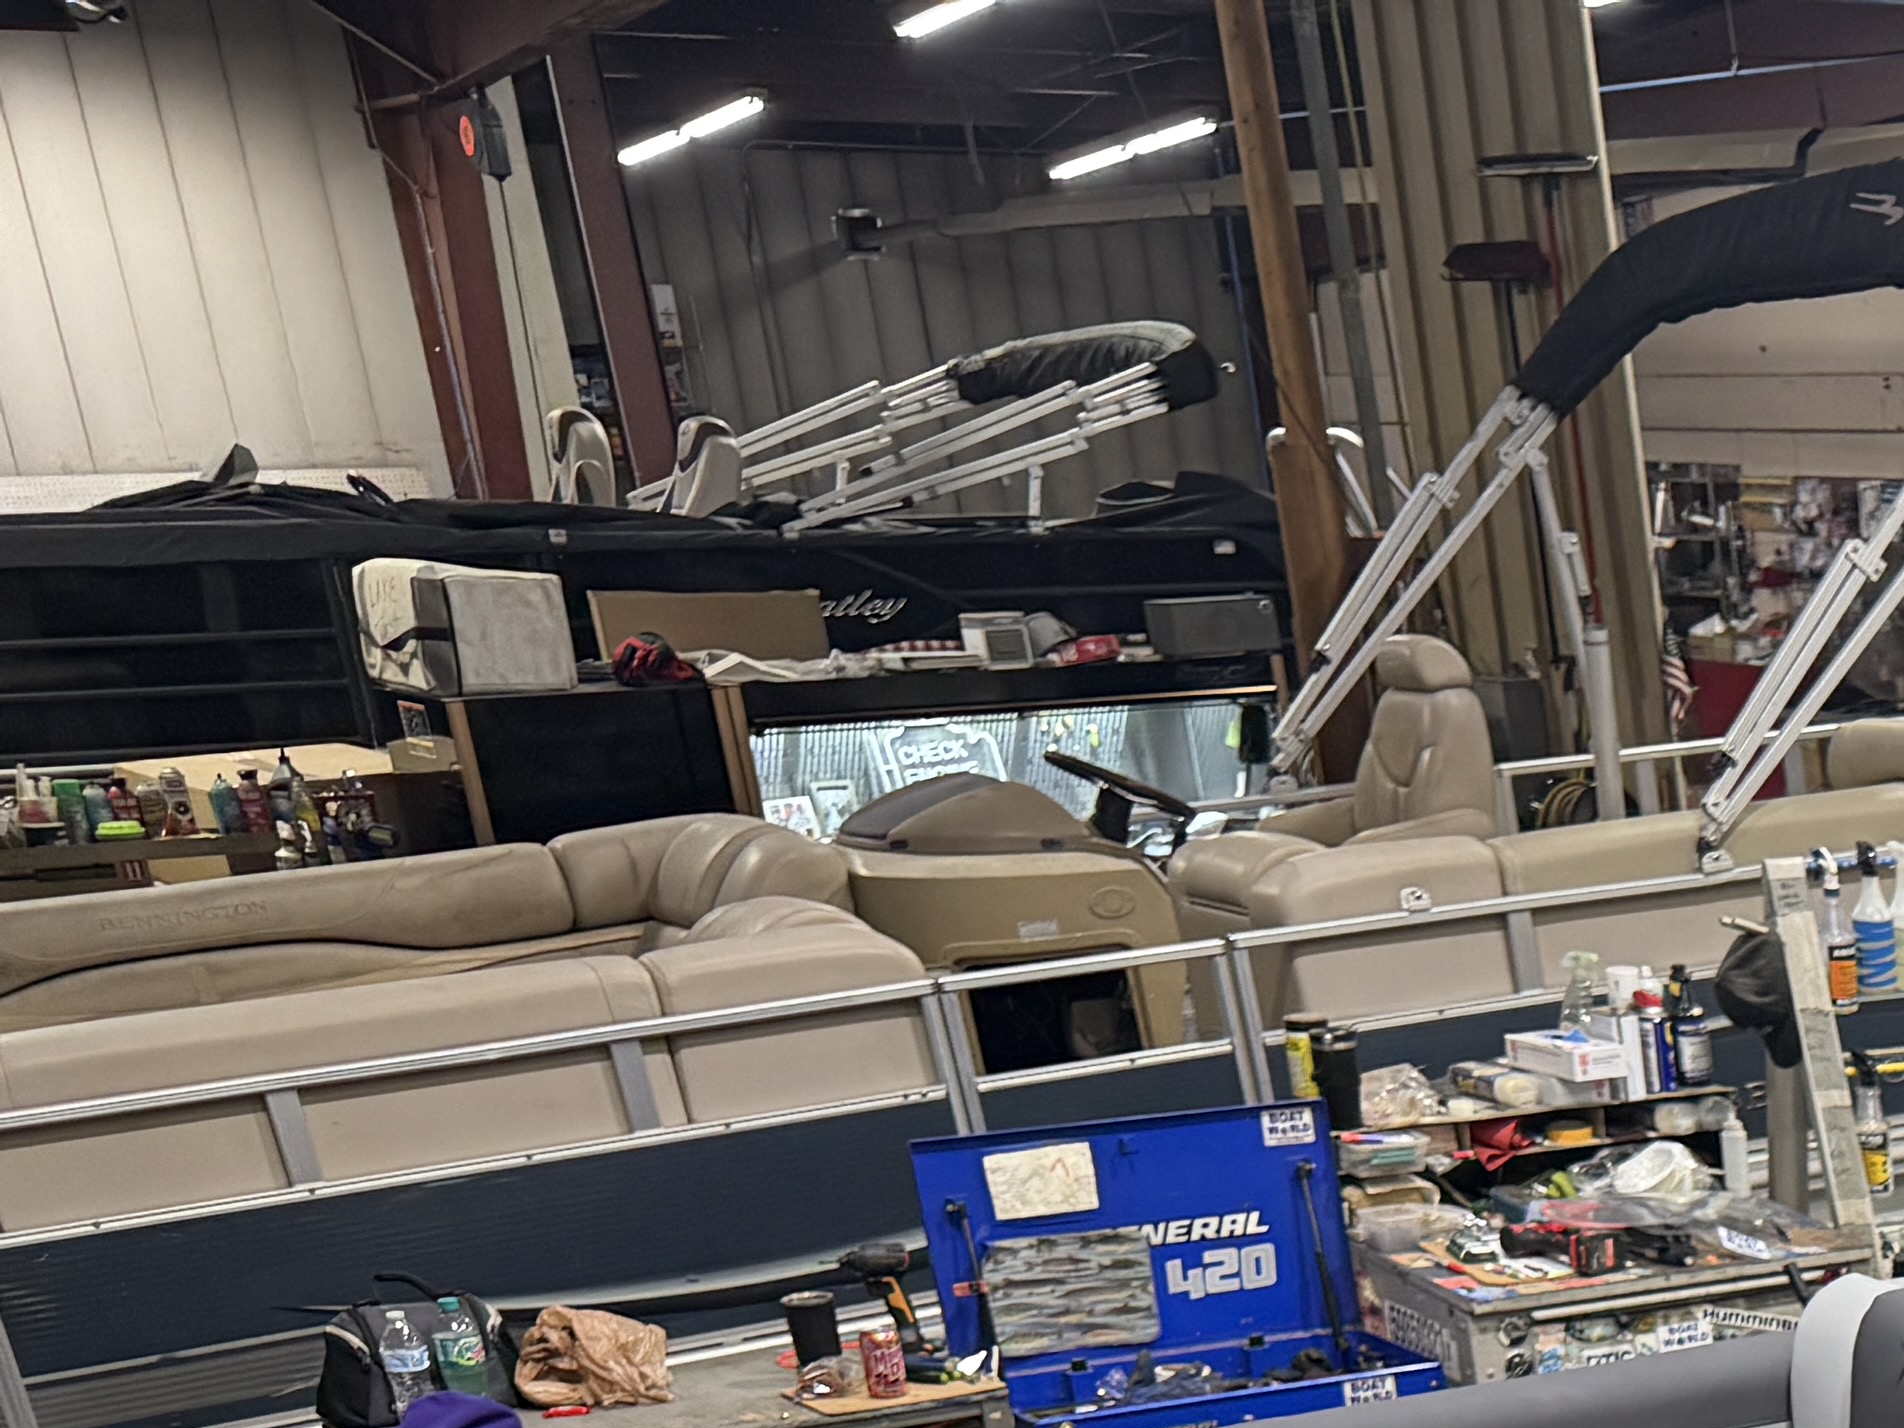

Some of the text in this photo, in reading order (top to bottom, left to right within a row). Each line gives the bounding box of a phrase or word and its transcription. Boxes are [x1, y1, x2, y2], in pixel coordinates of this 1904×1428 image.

[820, 589, 908, 624] ntley
[898, 739, 969, 766] CHECK
[100, 901, 268, 932] BENNINGTON
[1113, 1210, 1271, 1247] NERAL
[1164, 1242, 1278, 1300] 420
